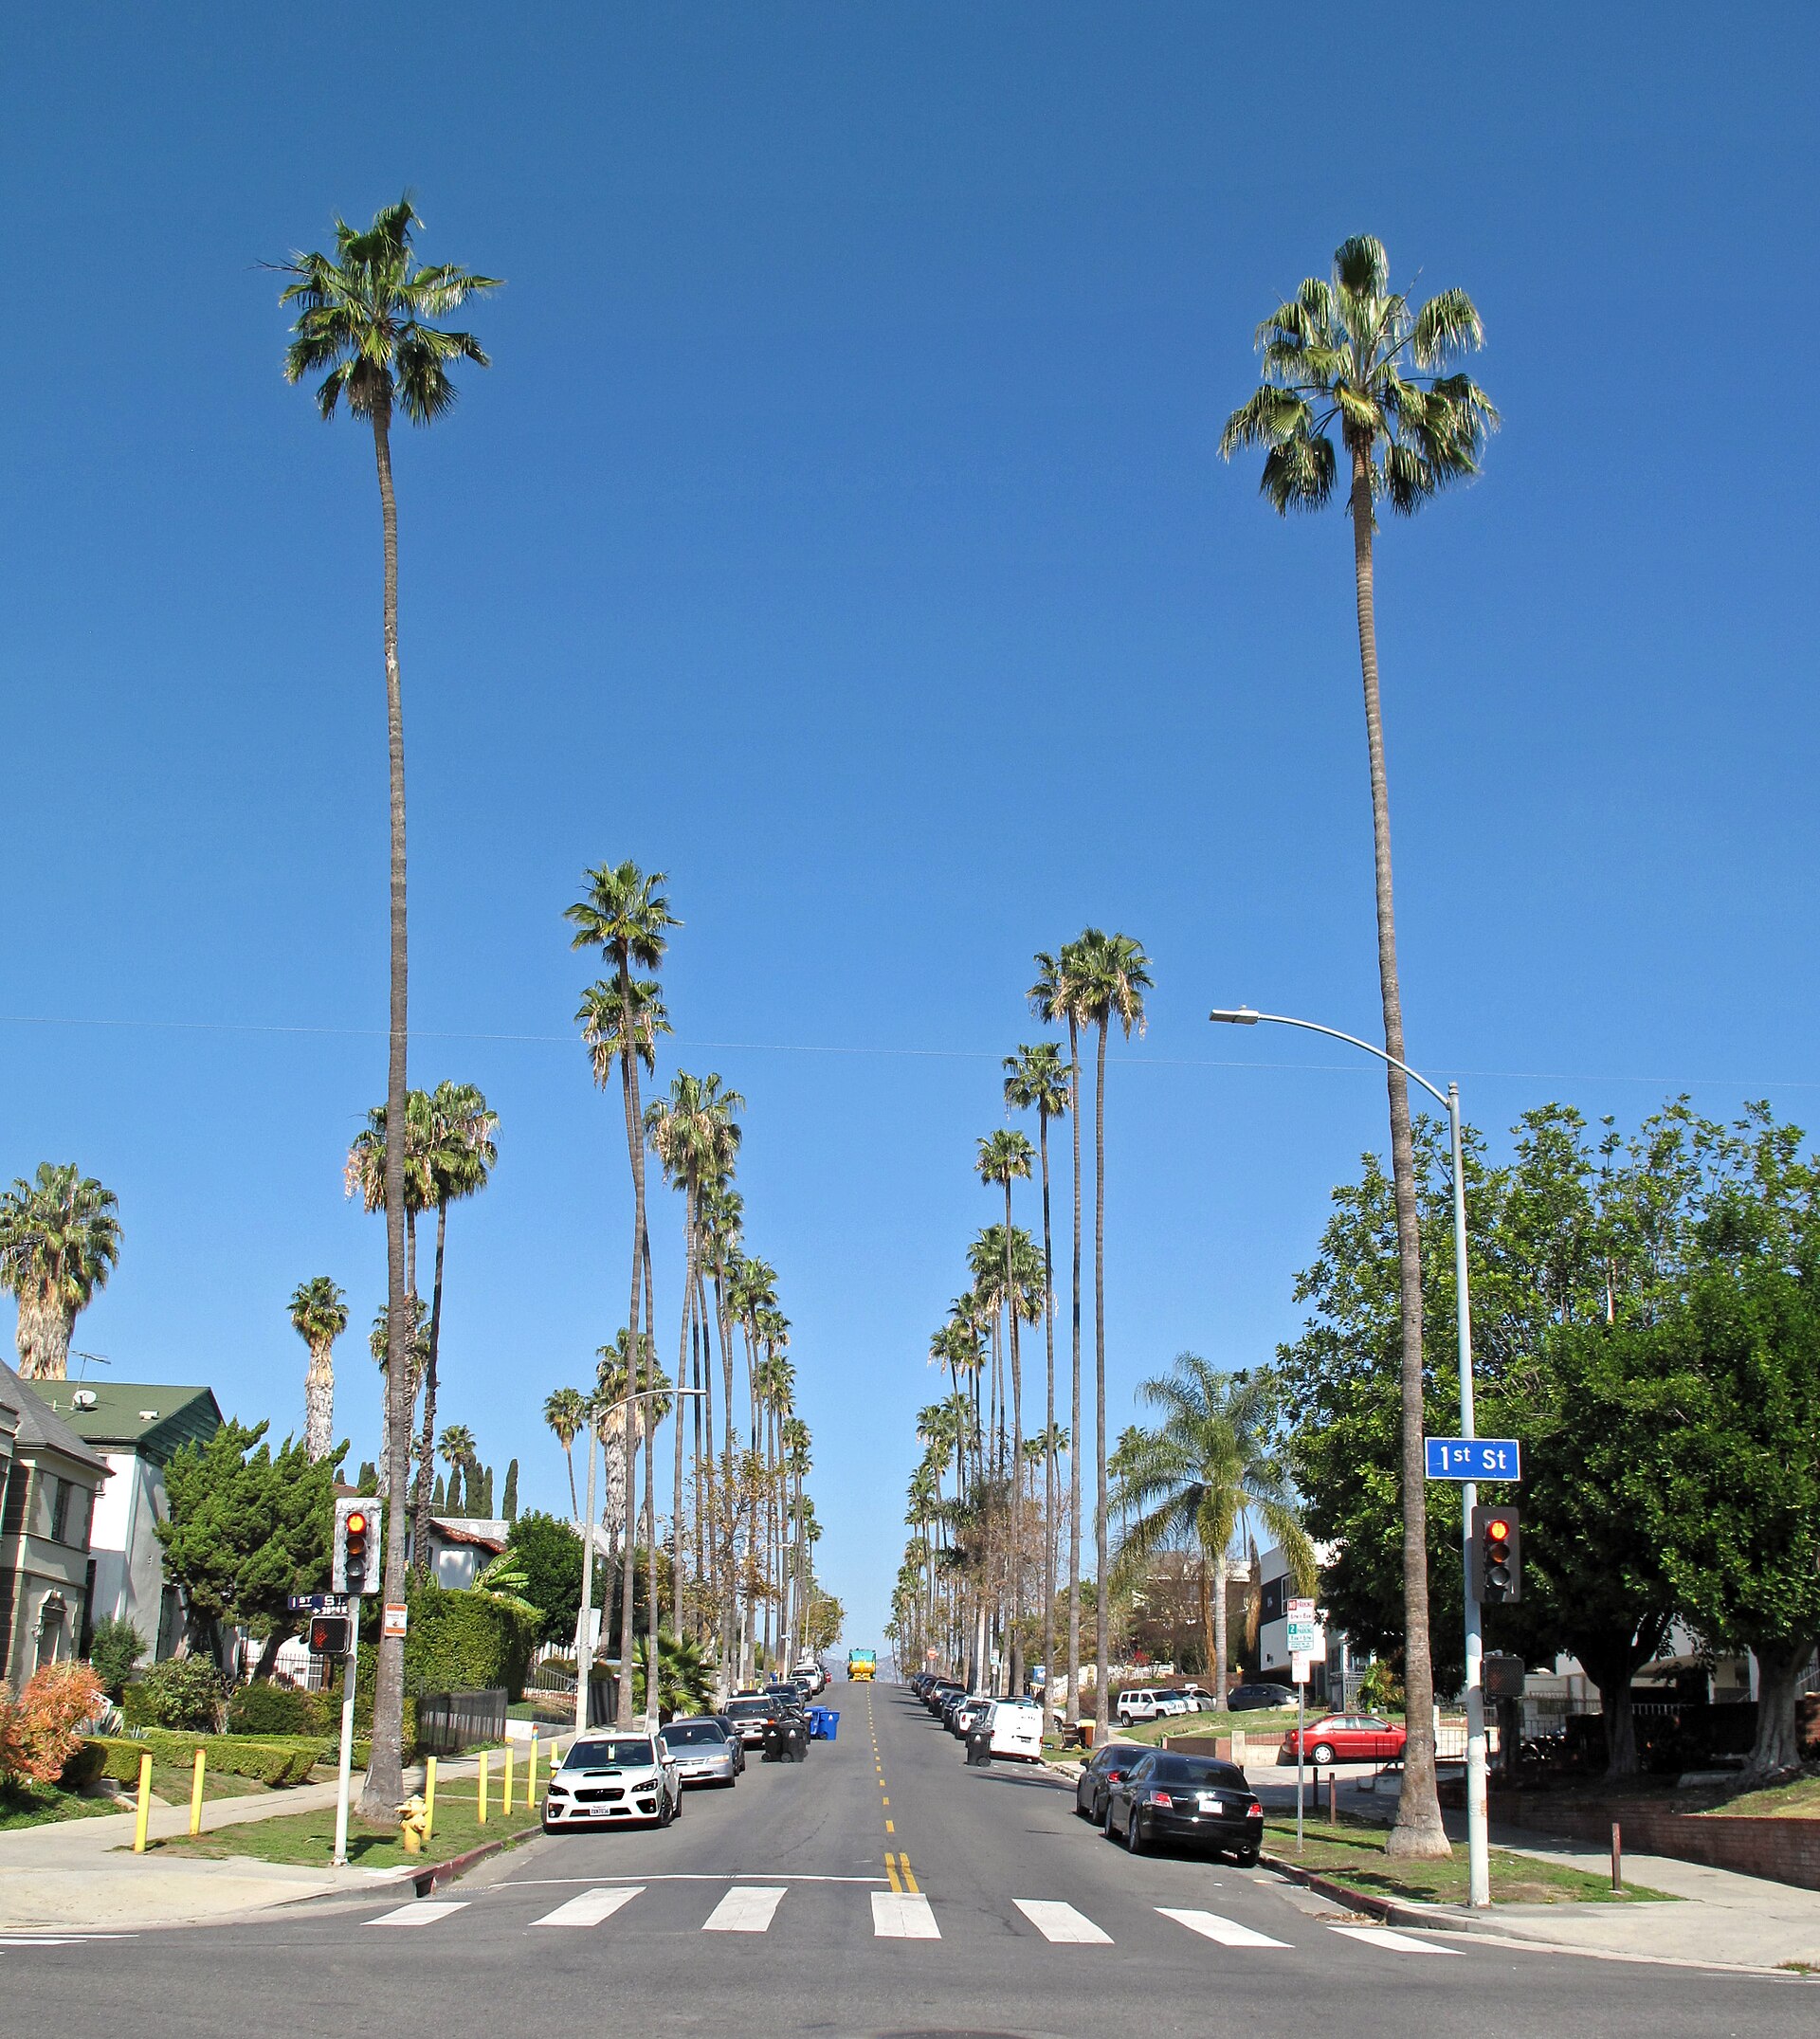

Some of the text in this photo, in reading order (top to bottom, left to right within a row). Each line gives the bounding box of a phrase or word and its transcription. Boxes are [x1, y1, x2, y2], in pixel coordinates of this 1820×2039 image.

[1440, 1446, 1507, 1471] 1st St
[1290, 1624, 1295, 1633] 2
